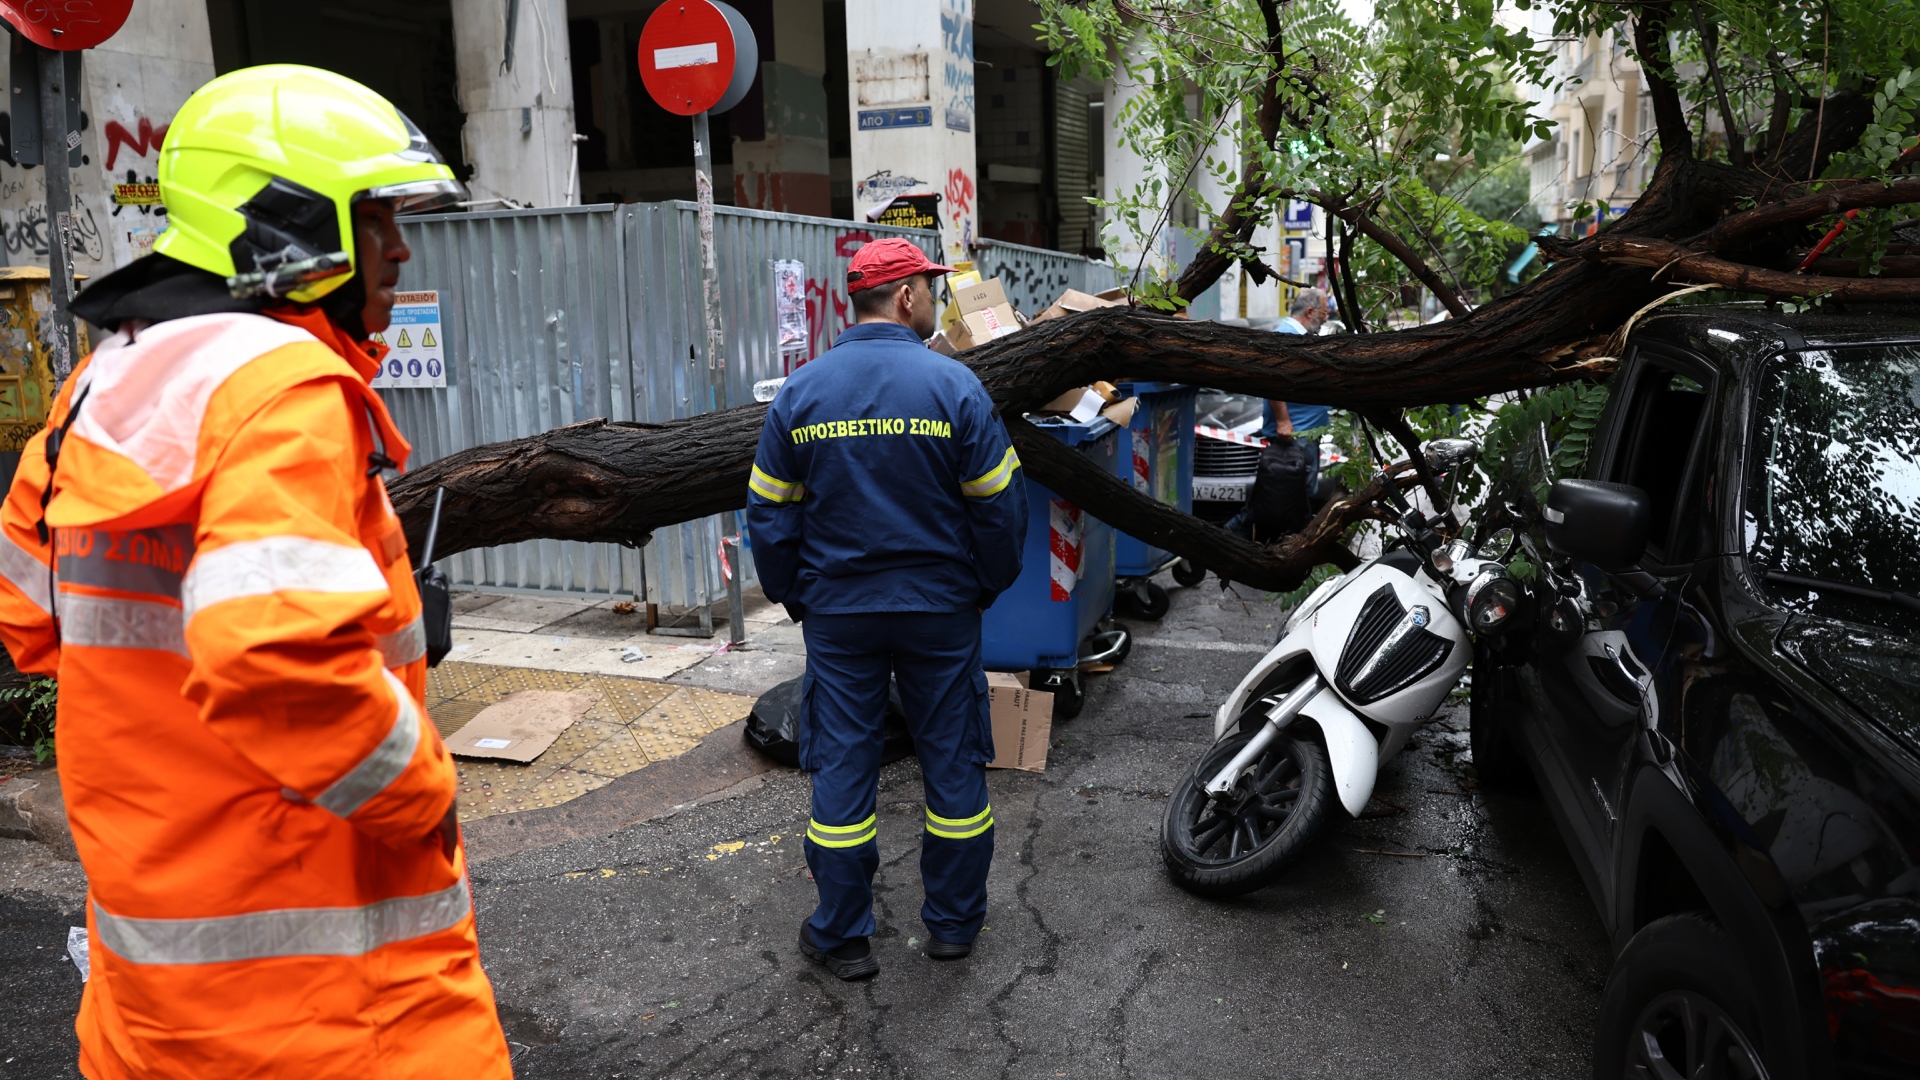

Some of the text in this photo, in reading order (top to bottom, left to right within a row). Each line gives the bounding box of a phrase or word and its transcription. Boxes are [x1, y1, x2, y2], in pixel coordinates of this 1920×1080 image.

[862, 110, 925, 127] ΑΠΟ 7 9
[395, 294, 435, 303] ΓΟΤΑΞΙΟΥ
[791, 418, 951, 445] ΠΥΡΟΣΒΕΣΤΙΚΟ ΣΩΜΑ
[104, 531, 185, 574] ΣΩΜΑ
[1017, 737, 1025, 766] RETOURNER
